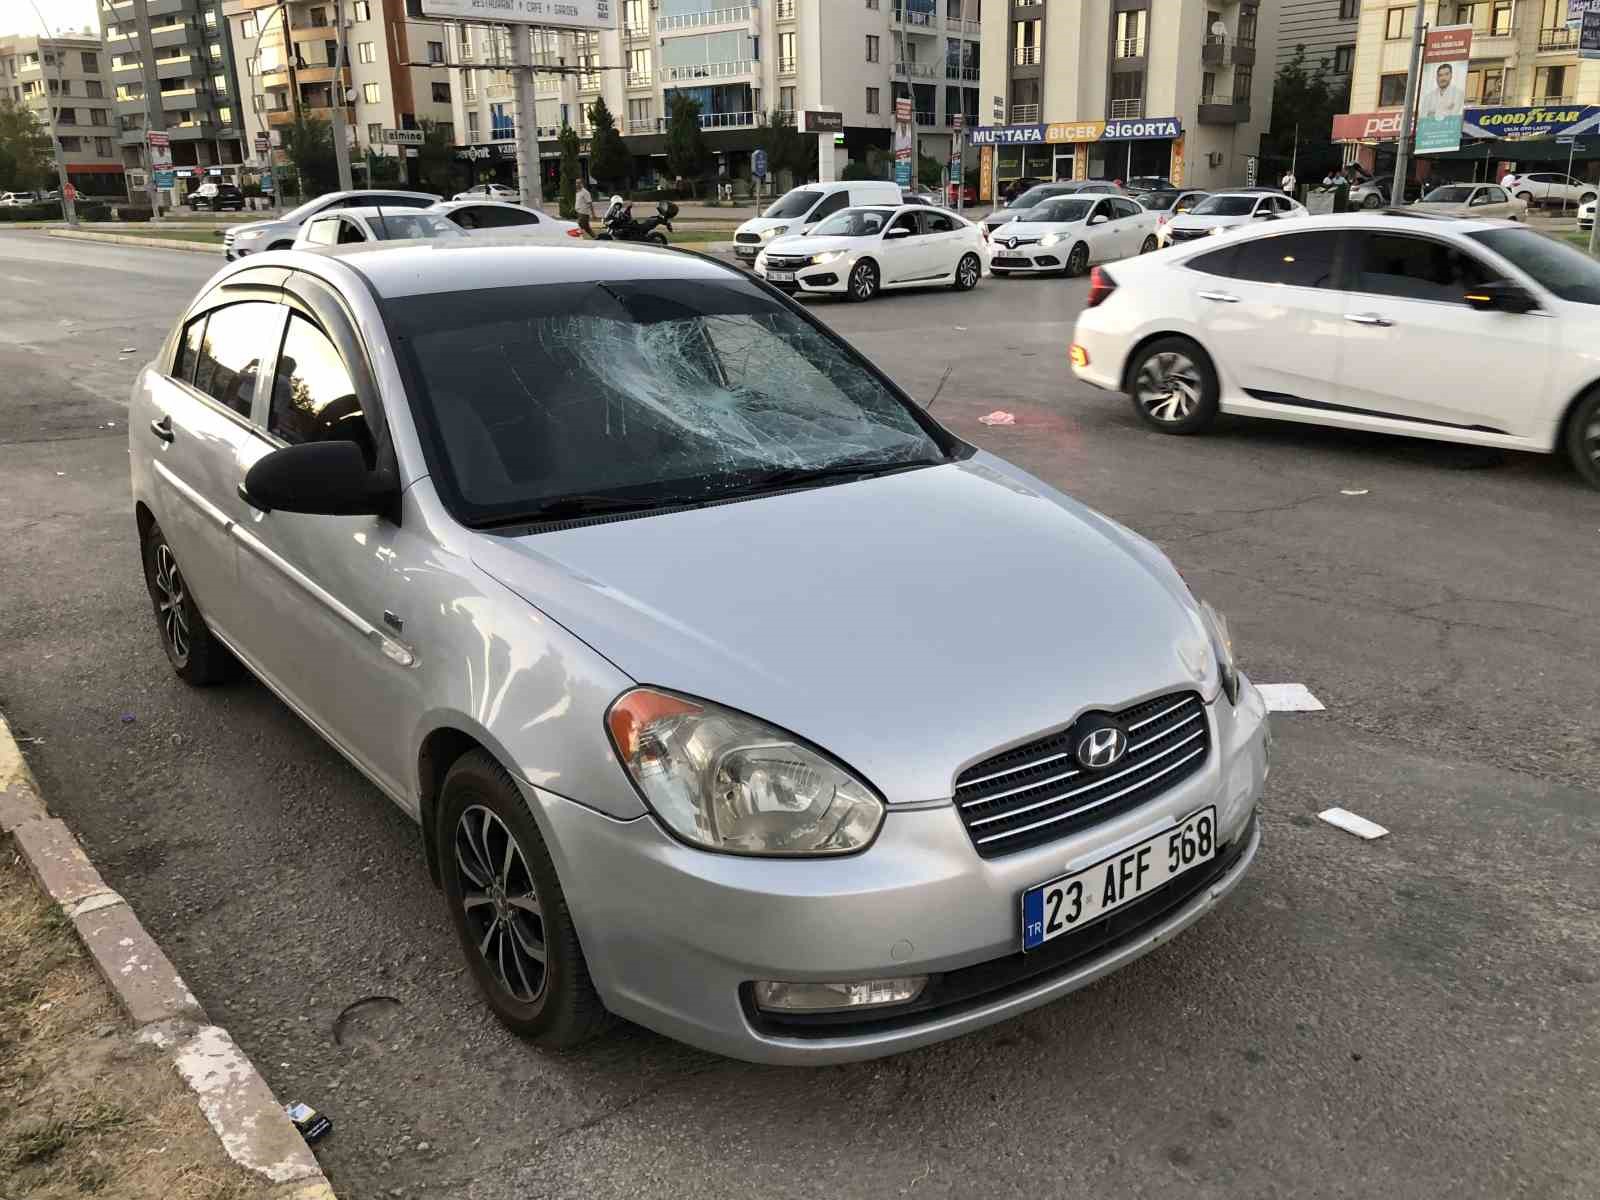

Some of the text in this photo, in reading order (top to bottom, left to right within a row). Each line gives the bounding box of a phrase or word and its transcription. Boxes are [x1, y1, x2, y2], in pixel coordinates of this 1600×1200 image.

[527, 2, 542, 14] CAFE
[554, 4, 578, 17] GARDEN
[1479, 109, 1580, 126] GOODYEAR
[1105, 121, 1177, 138] SİGORTA
[1046, 816, 1212, 934] 23 AFF 568
[1027, 921, 1042, 938] TR
